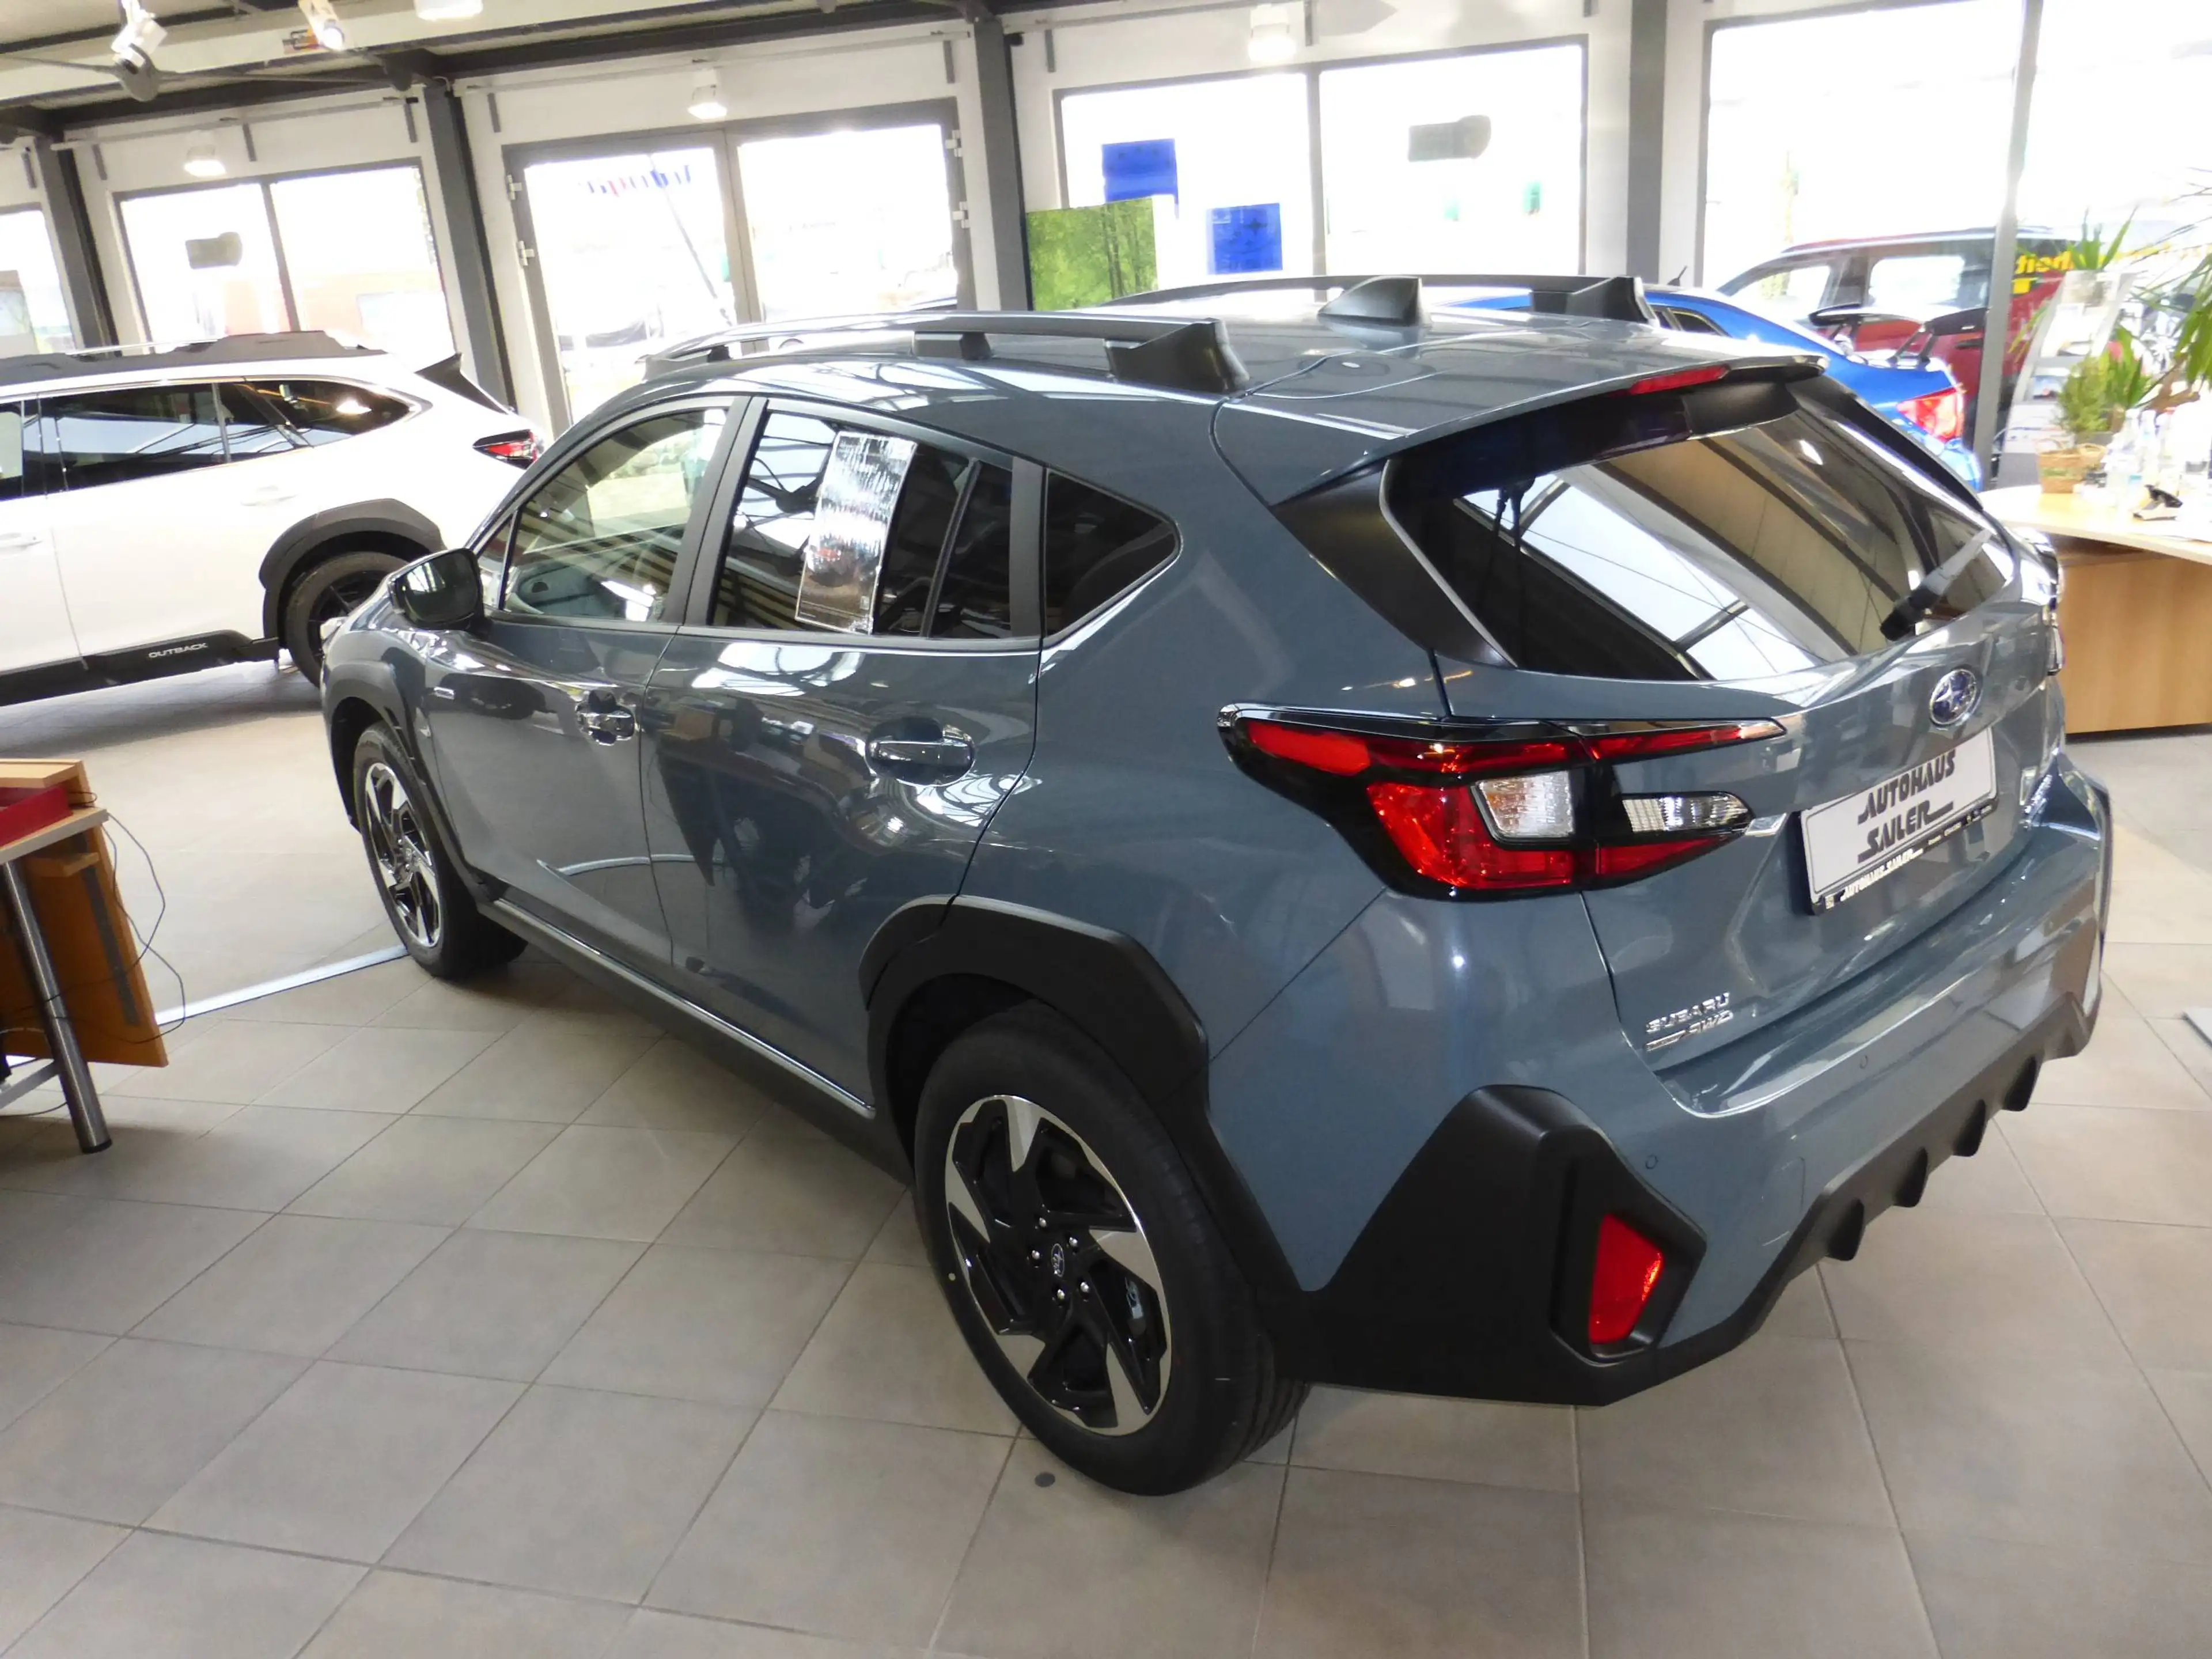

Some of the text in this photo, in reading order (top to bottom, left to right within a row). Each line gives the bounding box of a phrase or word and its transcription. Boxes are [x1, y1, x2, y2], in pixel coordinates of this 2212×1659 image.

[148, 642, 209, 658] OUTBACK
[1857, 751, 1956, 825] AUTOHAUS
[1857, 799, 1955, 863] SAILER
[1646, 991, 1730, 1034] SUBARU
